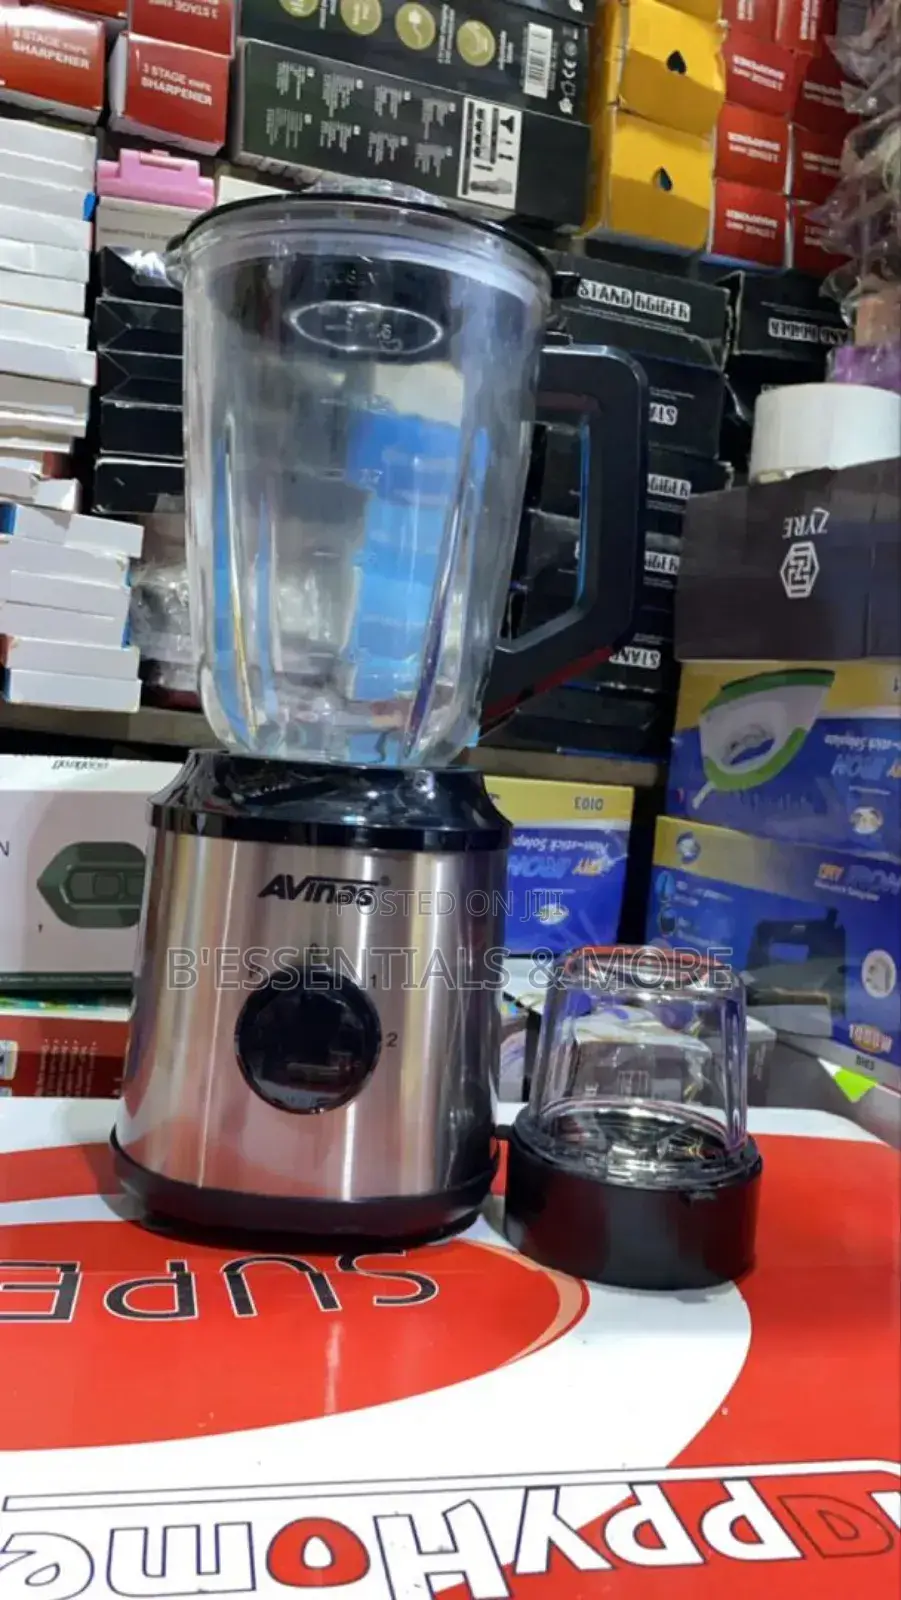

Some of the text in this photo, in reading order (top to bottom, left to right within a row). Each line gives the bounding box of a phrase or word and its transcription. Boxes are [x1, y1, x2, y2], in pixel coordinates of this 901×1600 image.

[12, 40, 91, 70] SHARPENER
[141, 77, 213, 106] SHARPENER
[577, 278, 633, 308] STAND
[782, 506, 831, 540] ZYRE
[386, 1032, 398, 1048] 2
